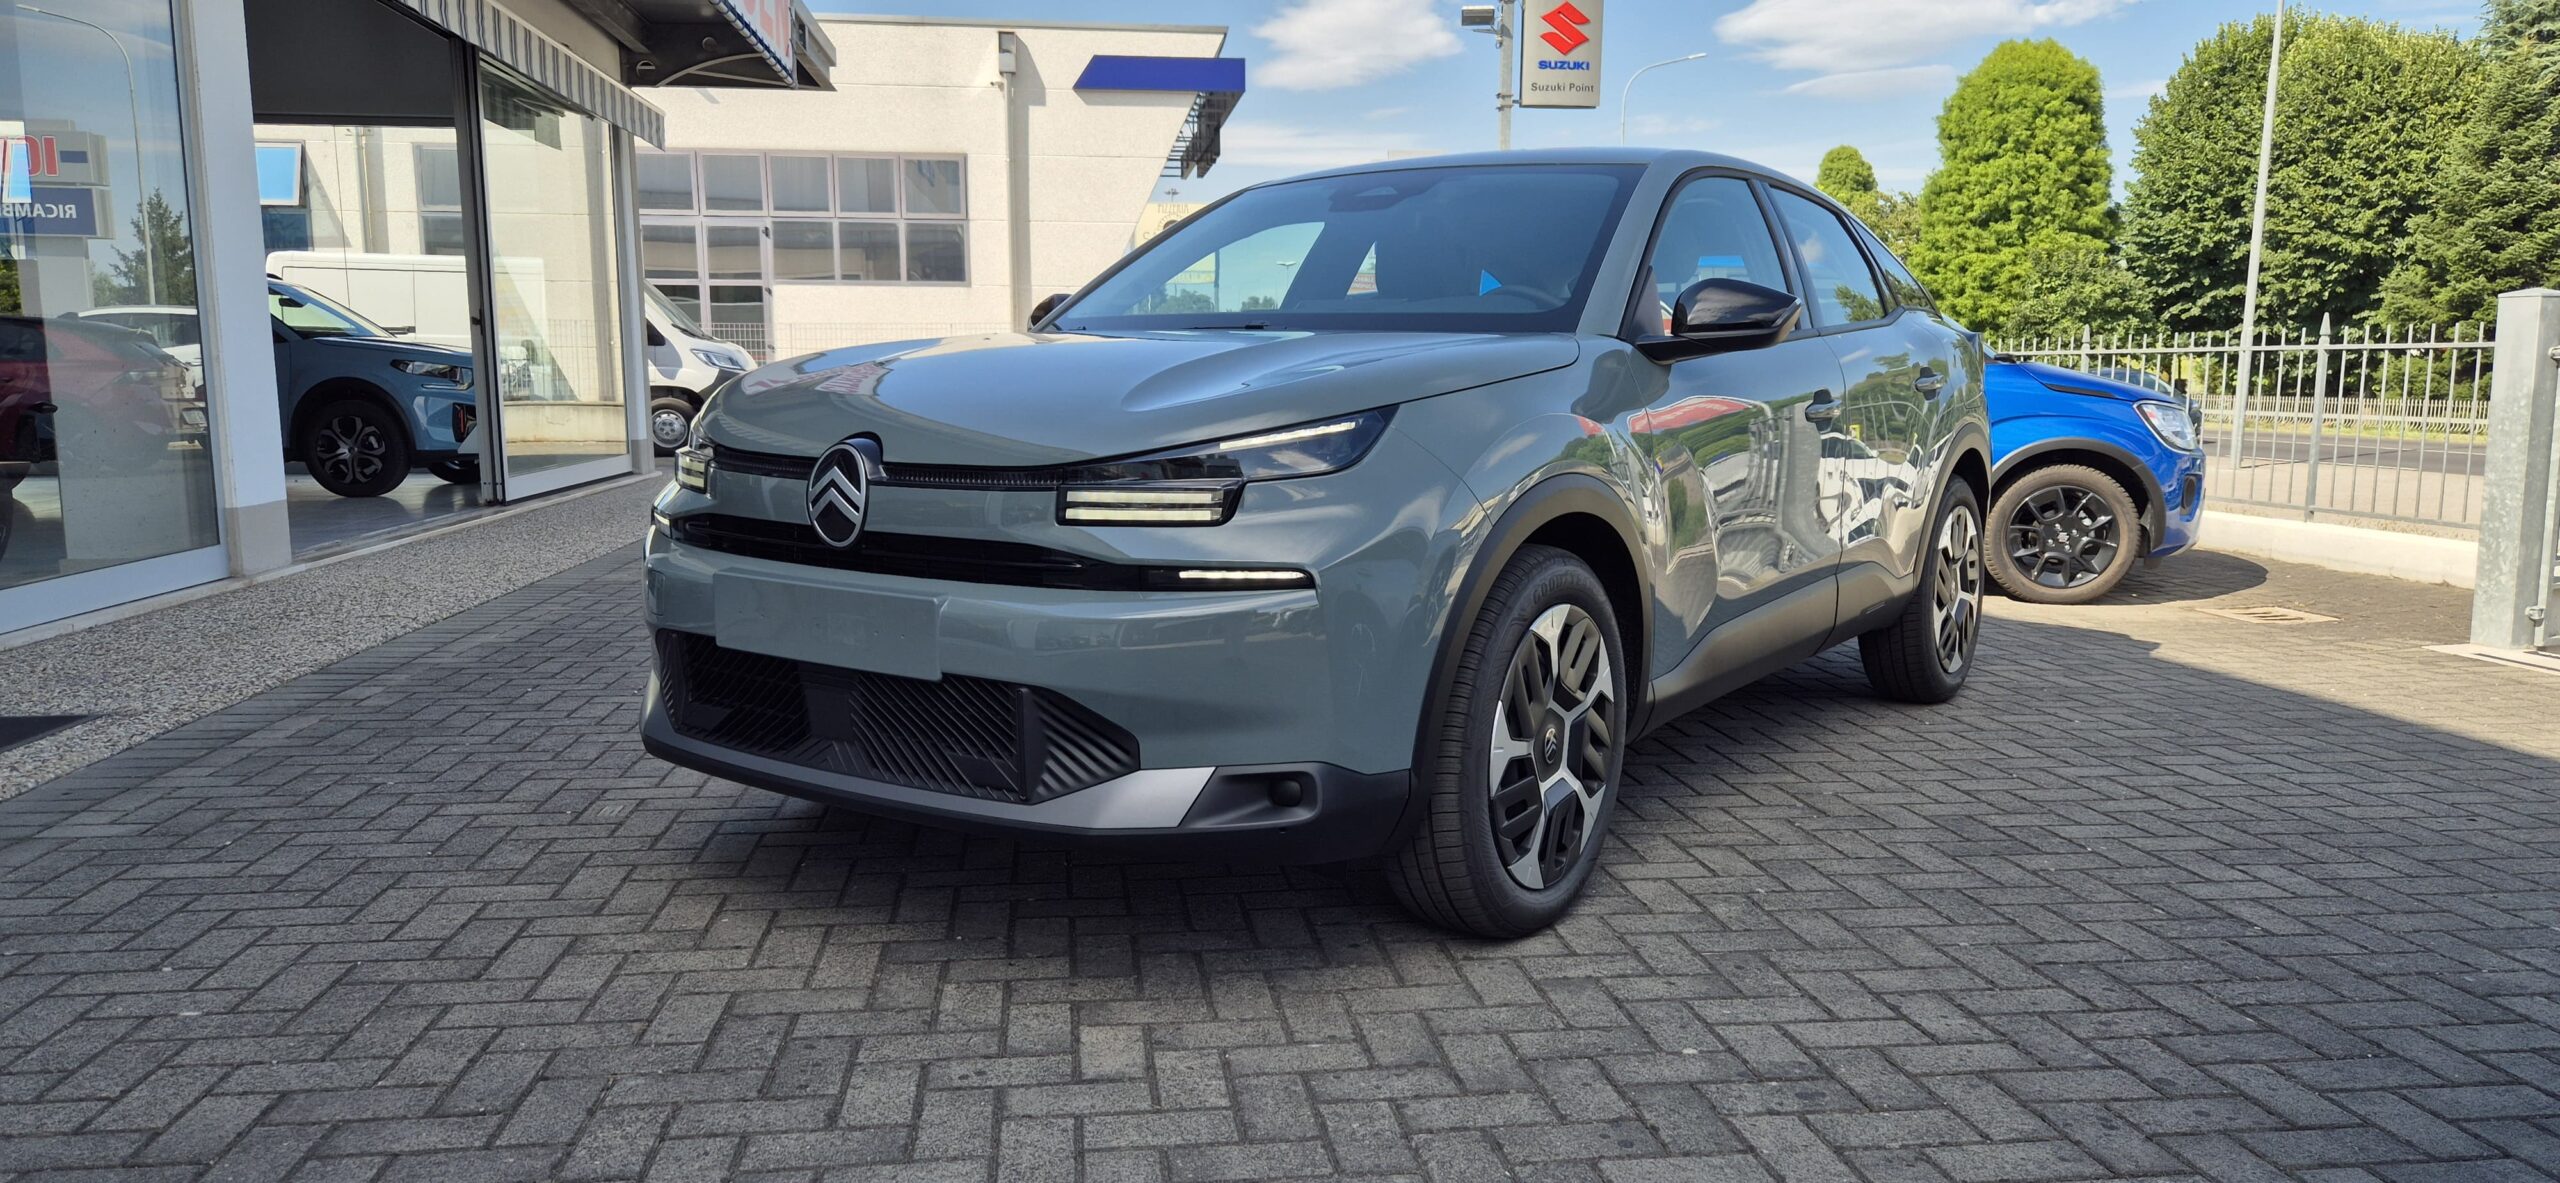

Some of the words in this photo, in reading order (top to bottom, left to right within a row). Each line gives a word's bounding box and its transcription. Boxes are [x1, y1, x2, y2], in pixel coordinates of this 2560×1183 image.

[1538, 60, 1590, 71] SUZUKI
[1531, 82, 1566, 92] Suzuki
[1569, 82, 1594, 93] Point
